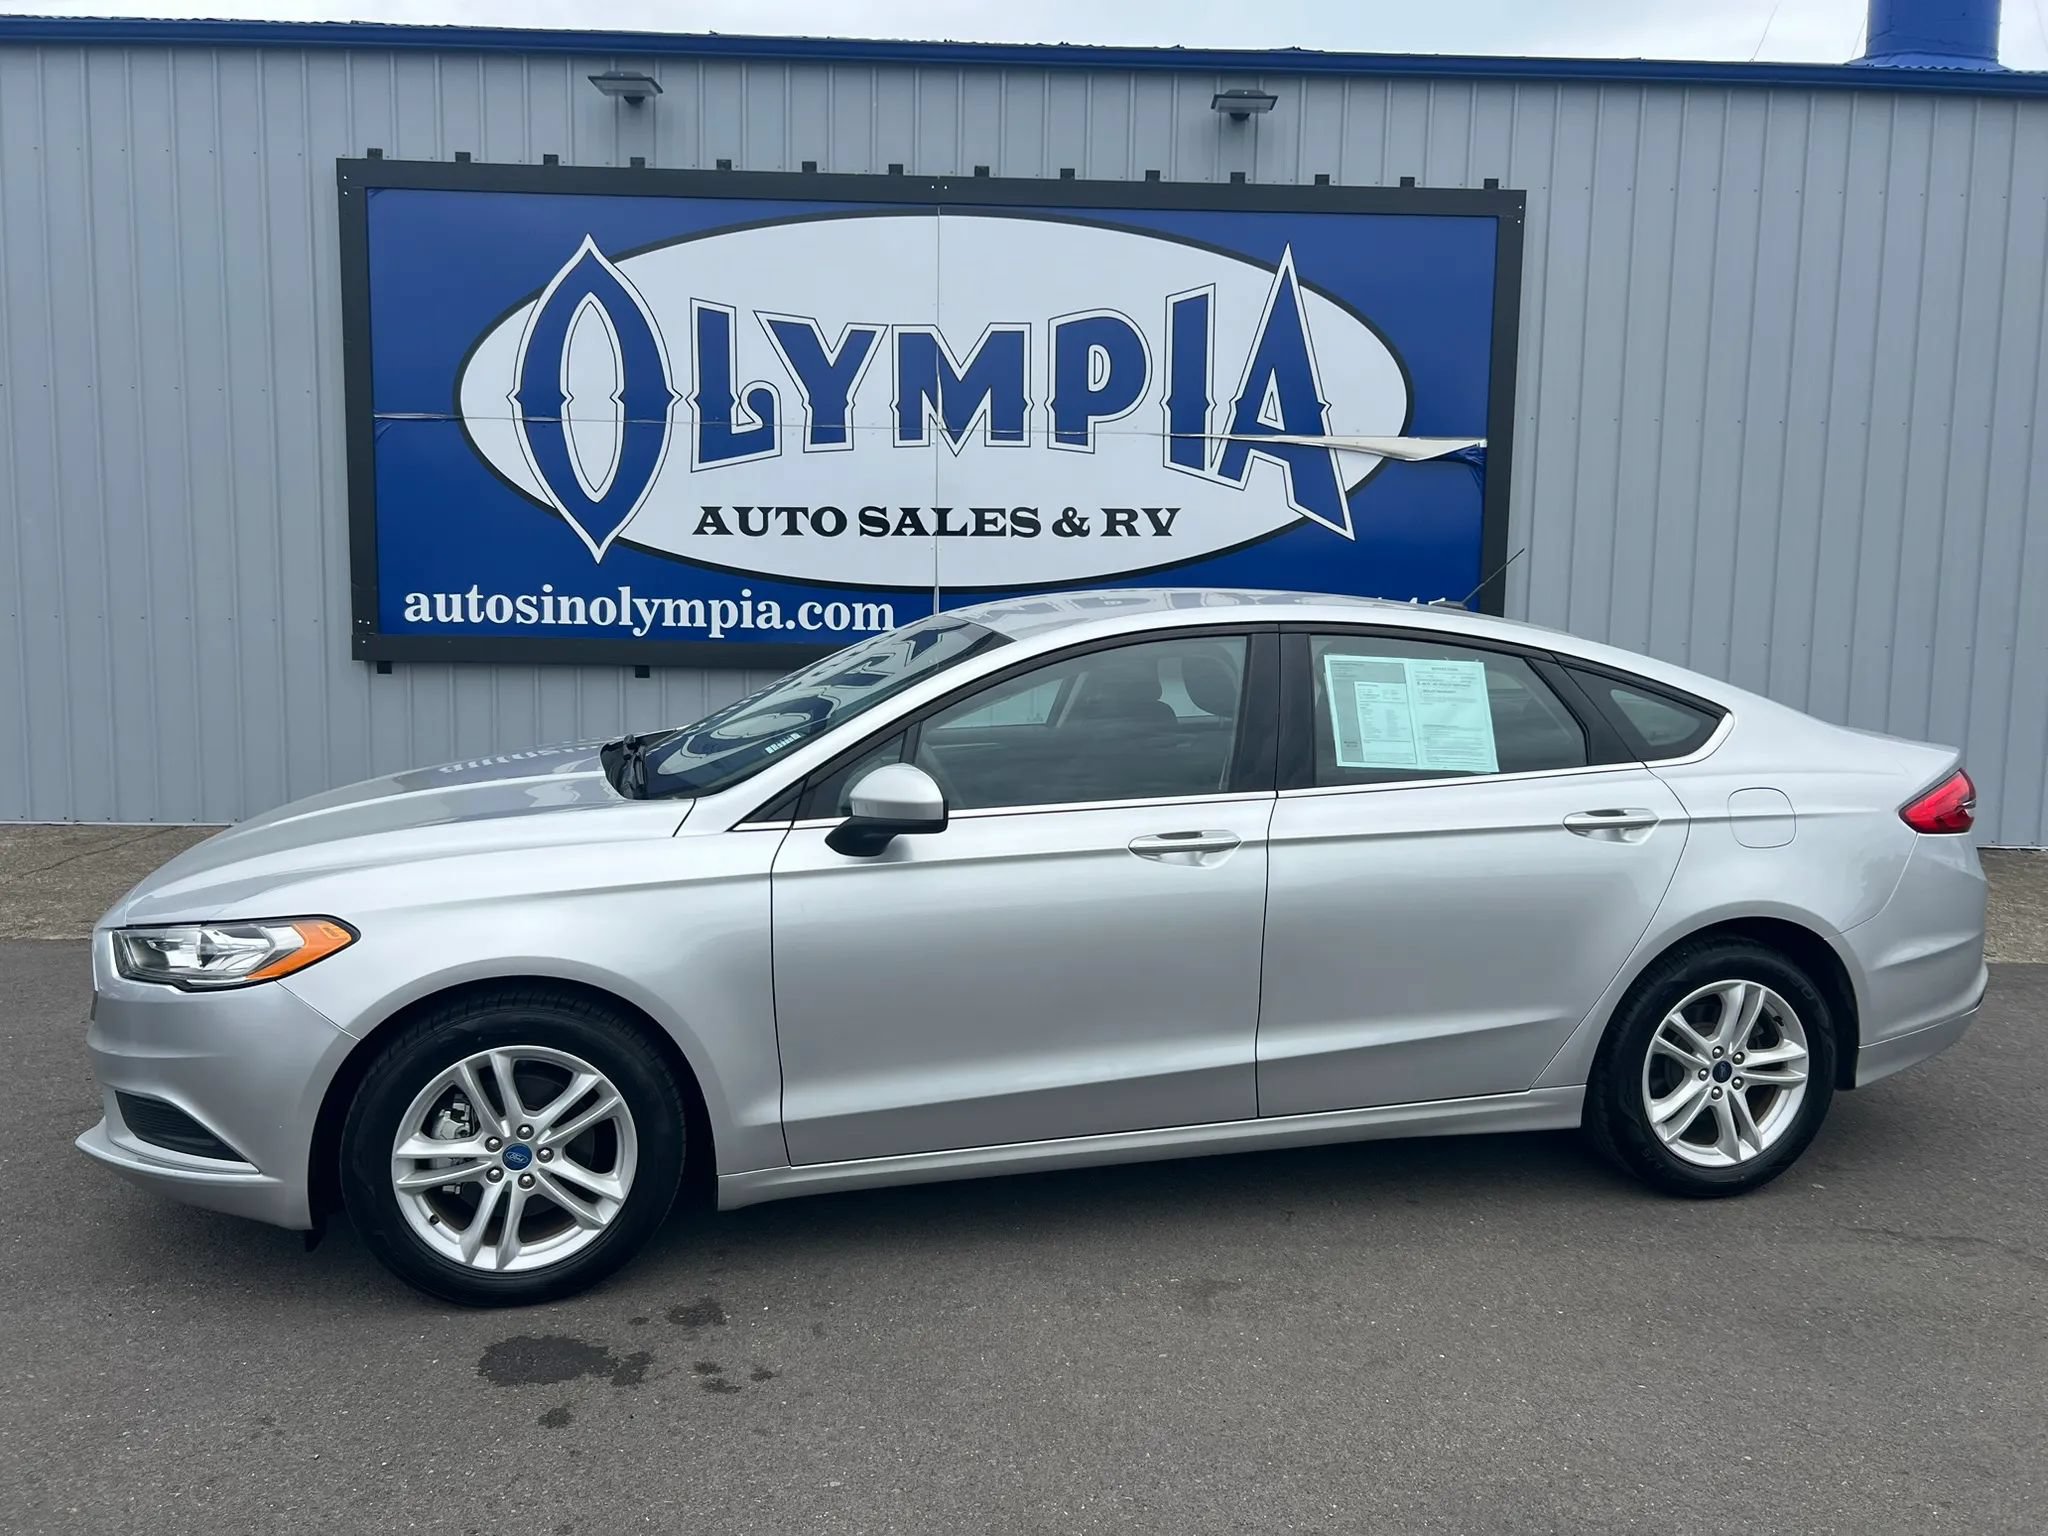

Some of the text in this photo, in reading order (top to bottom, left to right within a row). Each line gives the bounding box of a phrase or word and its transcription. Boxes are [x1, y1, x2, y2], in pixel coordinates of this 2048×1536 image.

[506, 233, 1355, 563] OLYMPIA
[692, 506, 1182, 538] AUTO SALES & RV
[403, 584, 895, 638] autosinolympia.com
